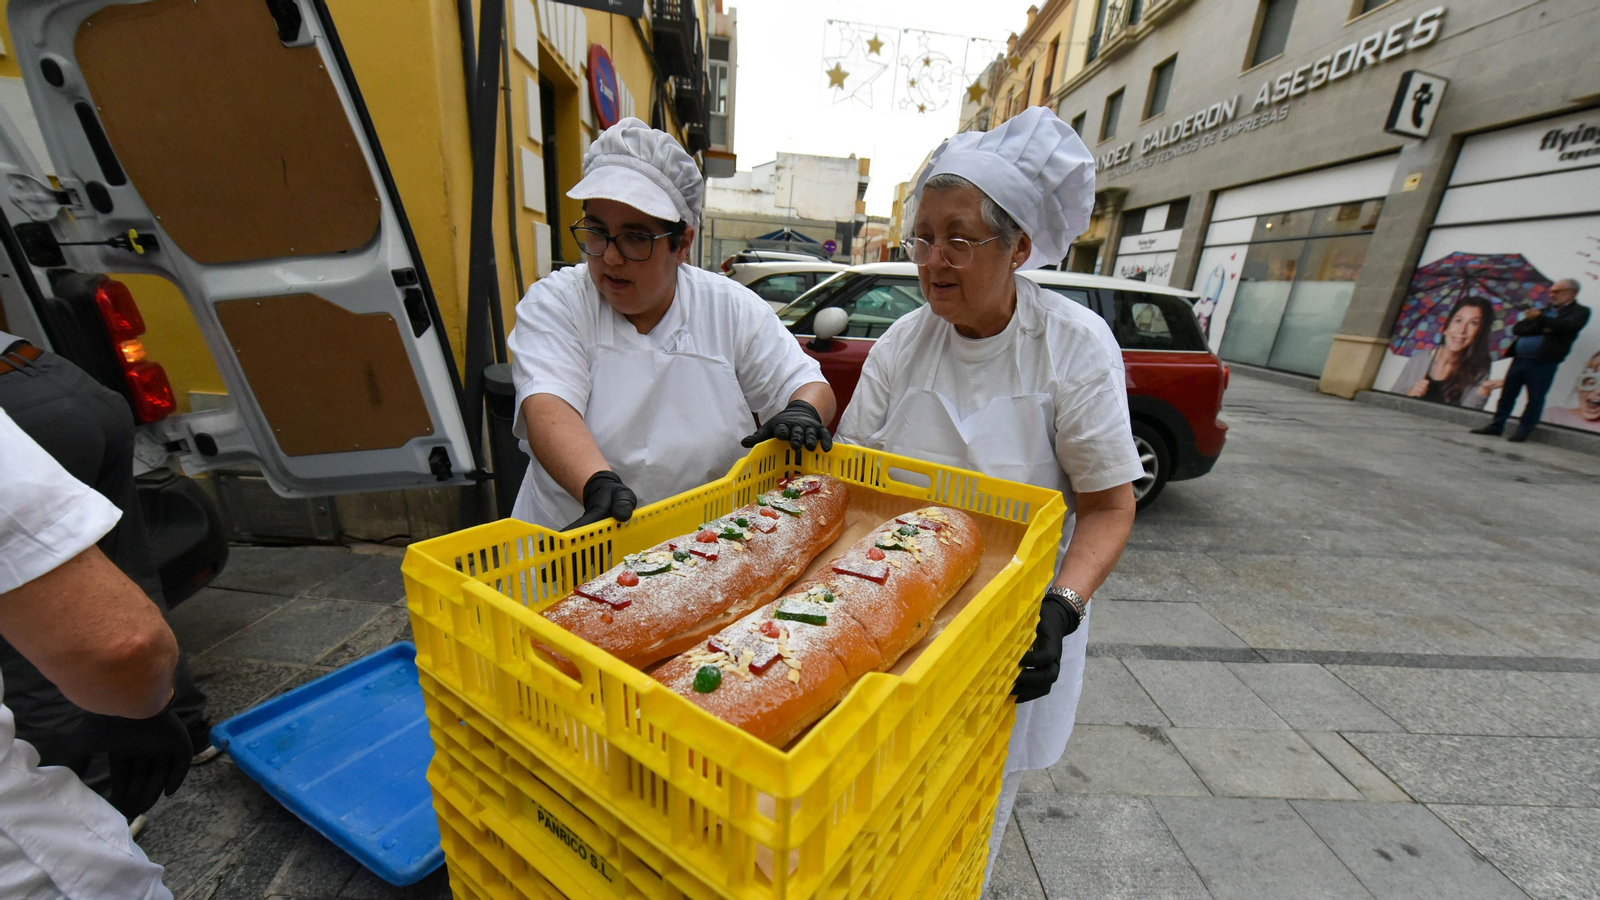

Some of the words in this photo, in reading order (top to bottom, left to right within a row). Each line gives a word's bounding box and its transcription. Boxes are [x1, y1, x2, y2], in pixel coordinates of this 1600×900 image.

[1140, 94, 1240, 154] CALDERON
[1252, 6, 1446, 110] ASESORES
[1202, 131, 1218, 148] DE
[1220, 104, 1291, 142] EMPRESAS
[537, 809, 587, 860] PANRICO
[590, 853, 613, 883] S.L.
